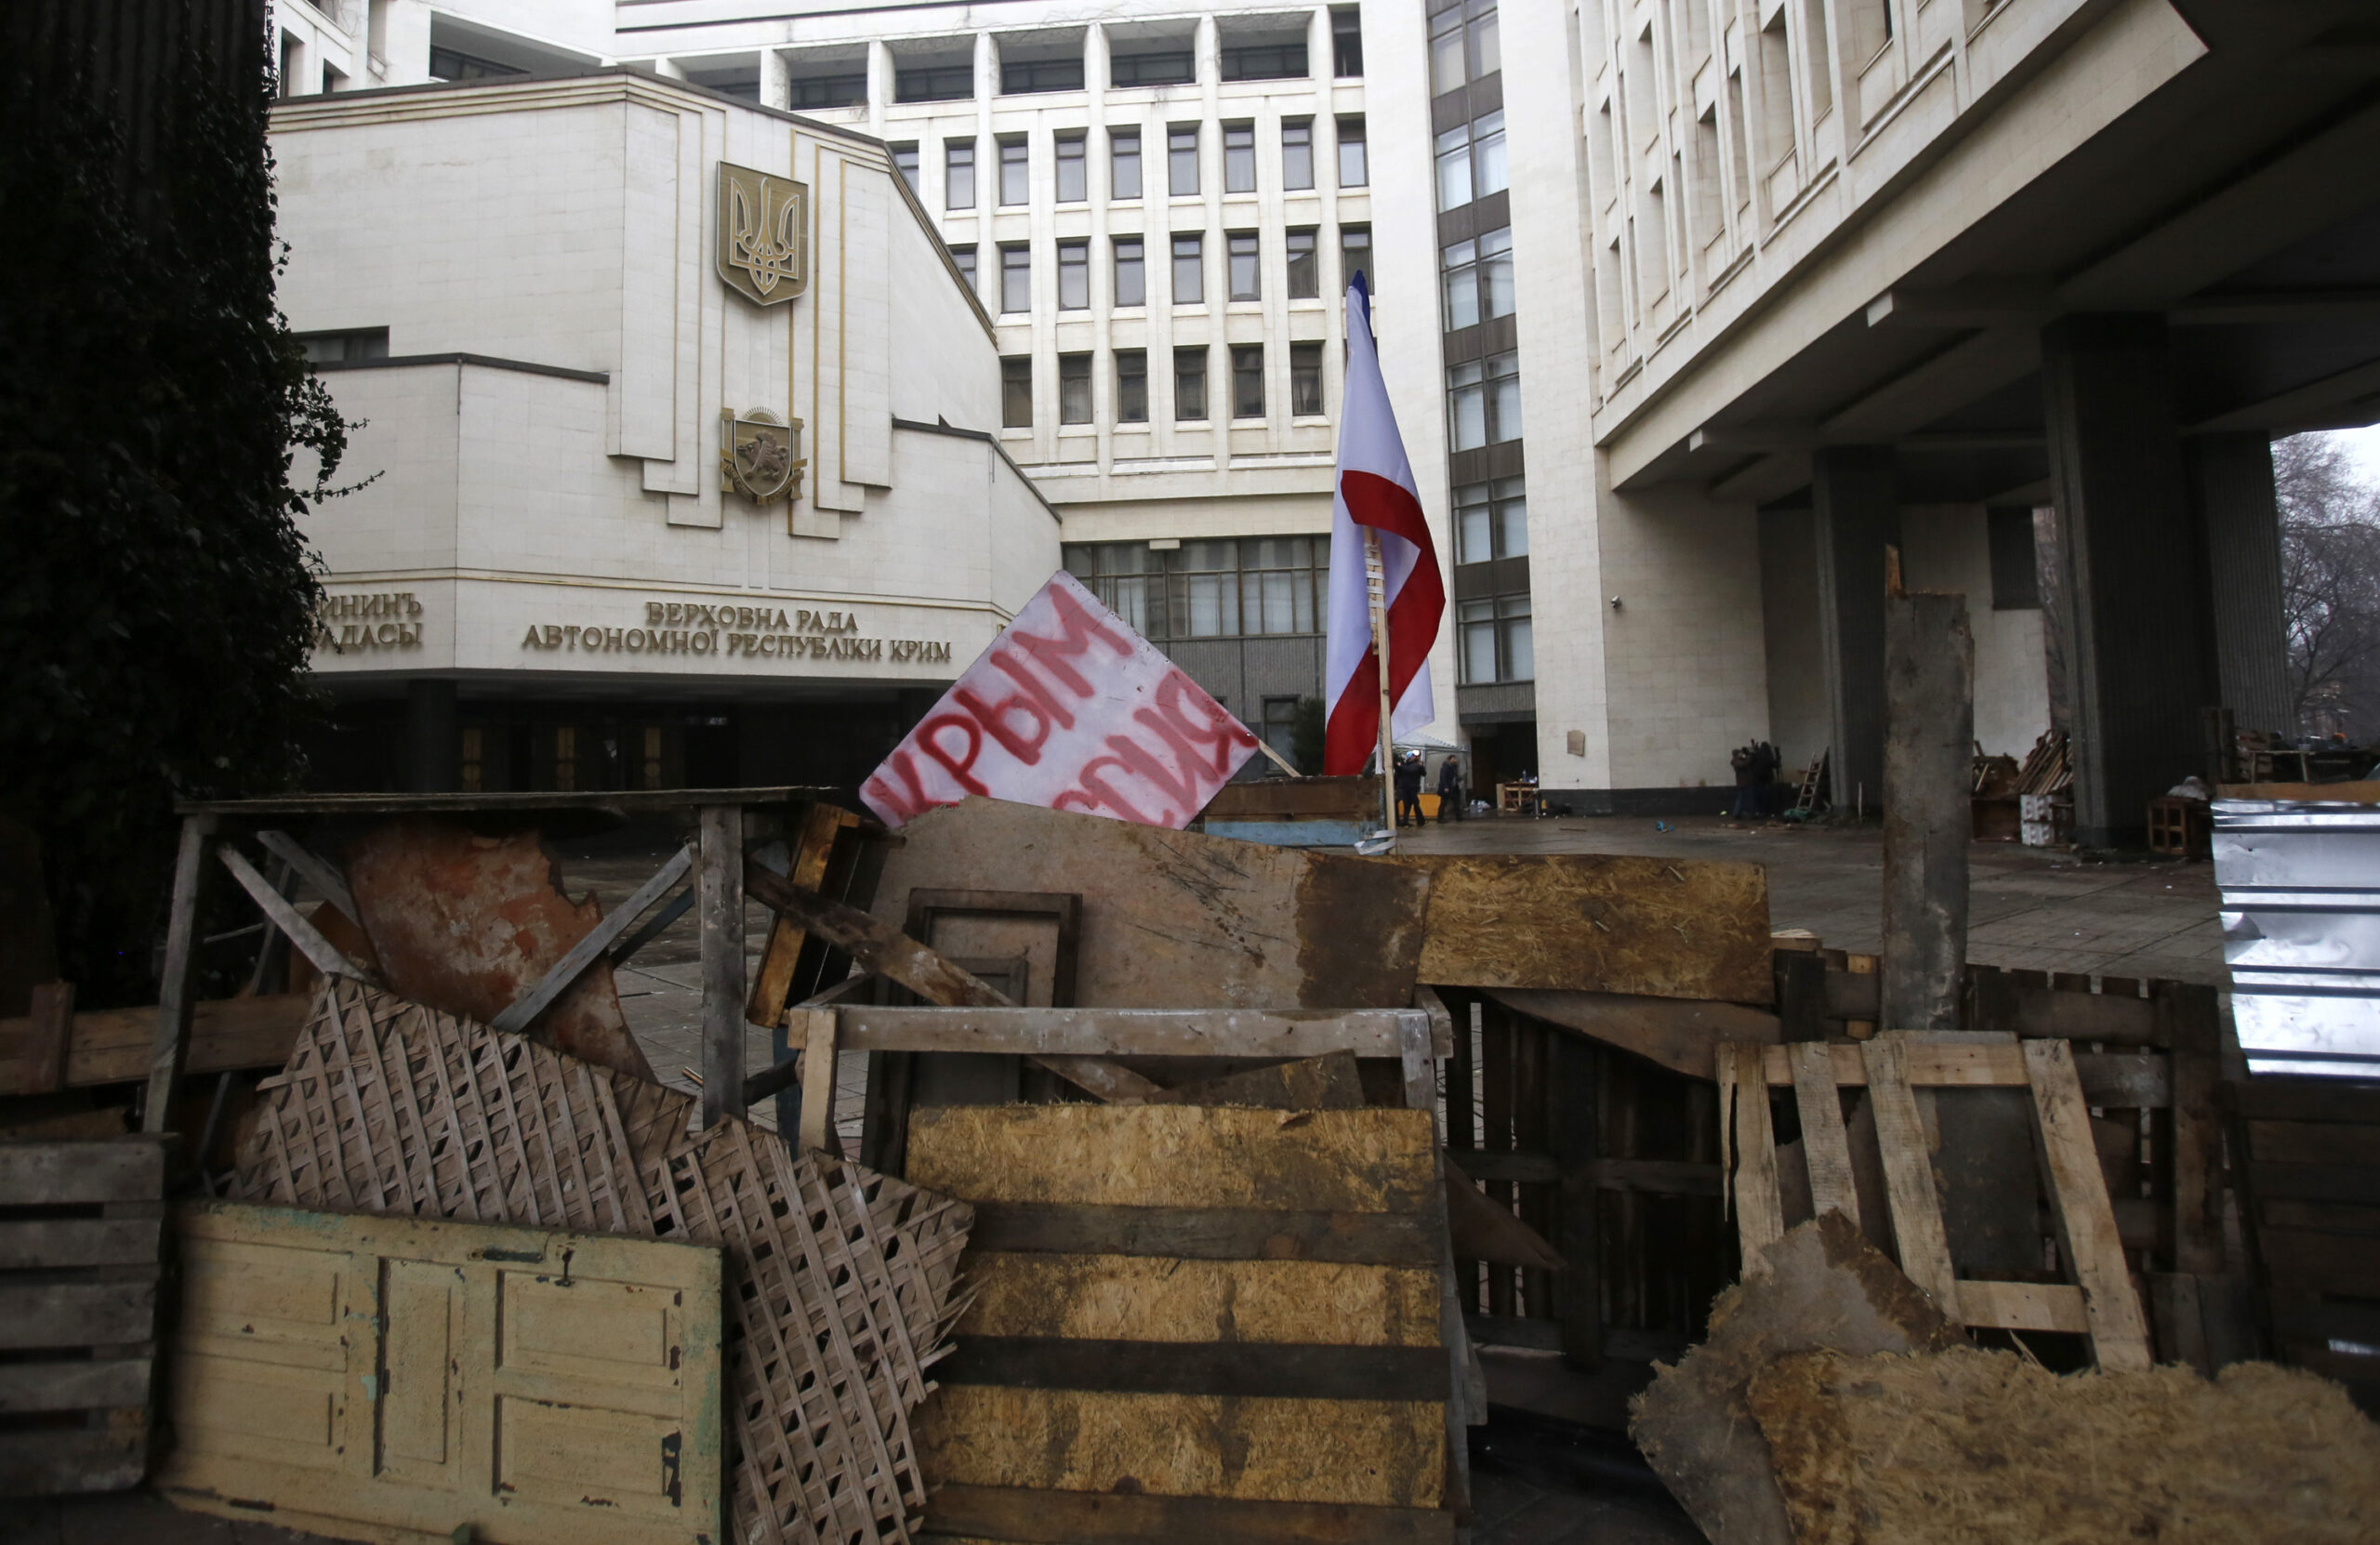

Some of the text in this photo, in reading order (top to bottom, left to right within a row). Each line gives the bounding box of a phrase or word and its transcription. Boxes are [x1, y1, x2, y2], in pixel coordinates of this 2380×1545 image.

[315, 592, 423, 617] ИНИНЪ
[646, 601, 859, 634] ВЕРХОВНА РАДА
[311, 622, 423, 648] АДАСЫ
[522, 624, 952, 660] АВТОНОМНОЇ РЕСПУБЛІКИ КРИМ
[868, 583, 1134, 824] КРЫМ
